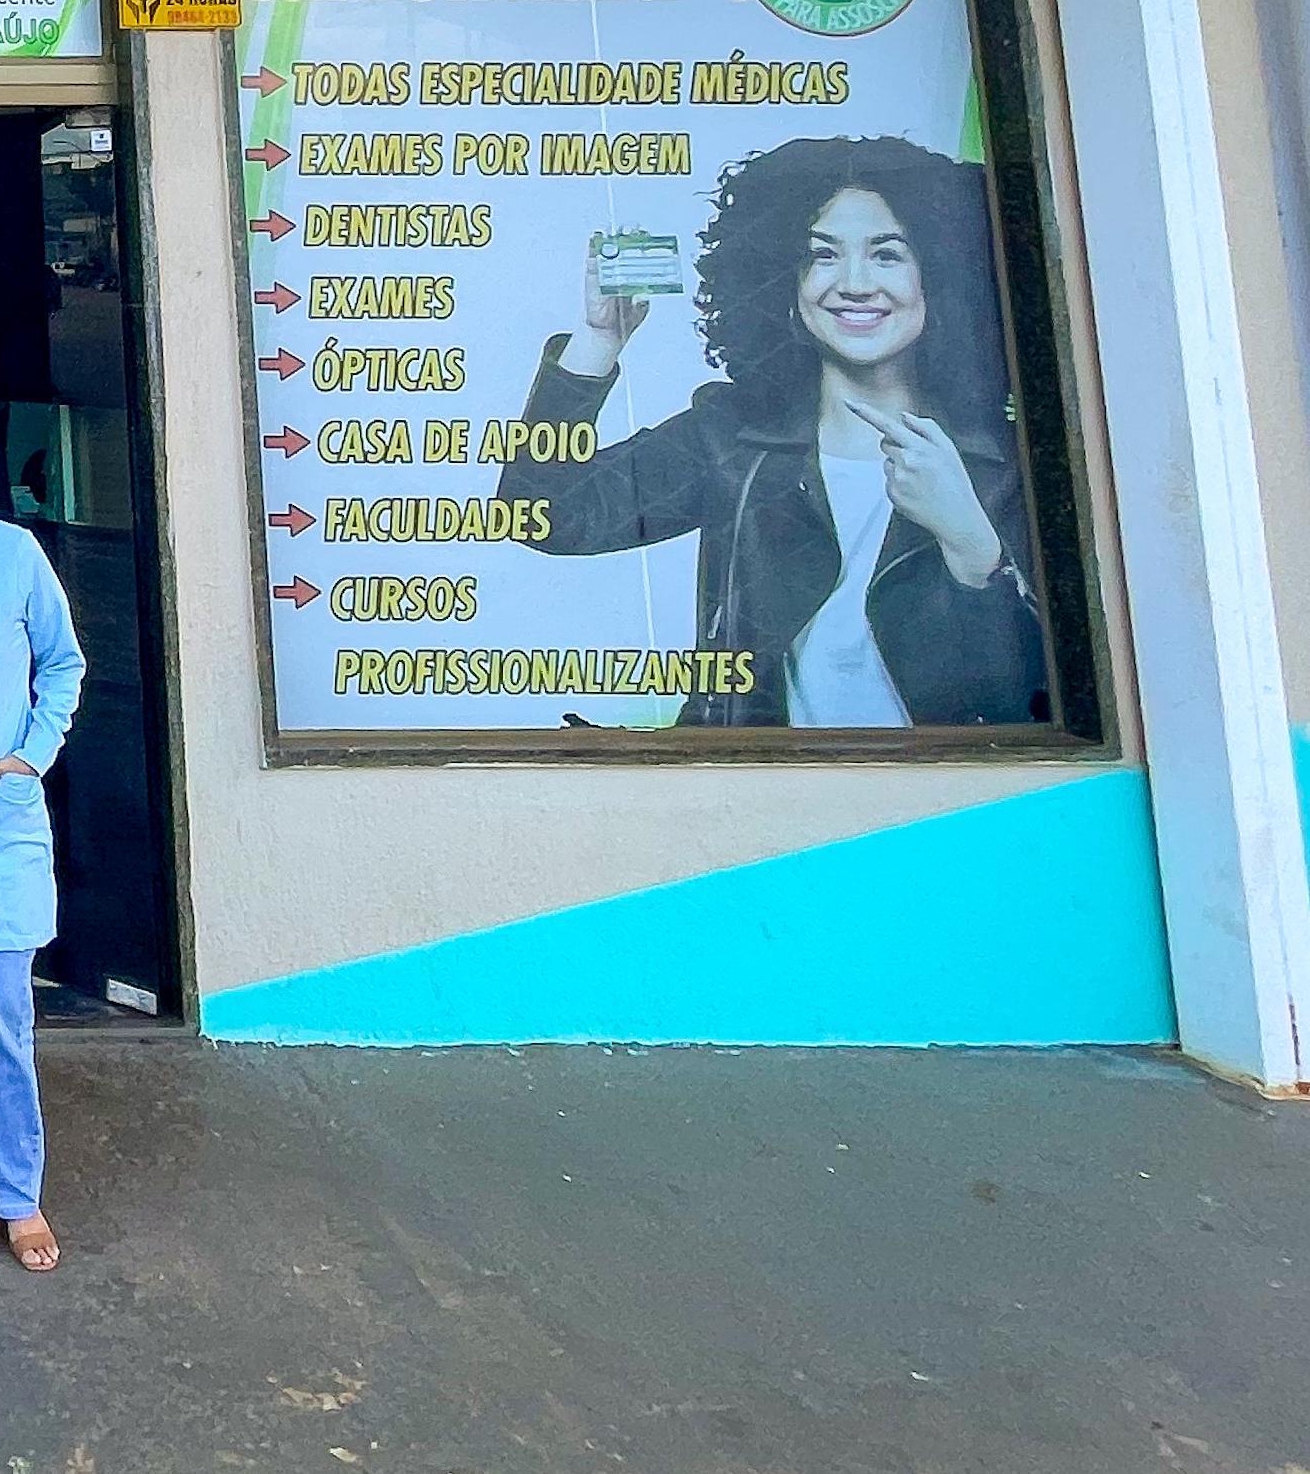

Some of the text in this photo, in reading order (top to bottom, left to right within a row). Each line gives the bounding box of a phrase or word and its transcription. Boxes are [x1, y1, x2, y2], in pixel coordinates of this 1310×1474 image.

[292, 48, 850, 105] TODAS ESPECIALIDADE MÉDICAS
[299, 133, 692, 176] EXAMES POR IMAGEM
[303, 205, 491, 247] DENTISTAS
[308, 276, 455, 319] EXAMES
[312, 337, 465, 392] ÓPTICAS
[317, 420, 597, 464] CASA DE APOIO
[323, 498, 551, 542] FACULDADES
[330, 576, 477, 621] CURSOS
[334, 650, 755, 696] PROFISSIONALIZANTES
